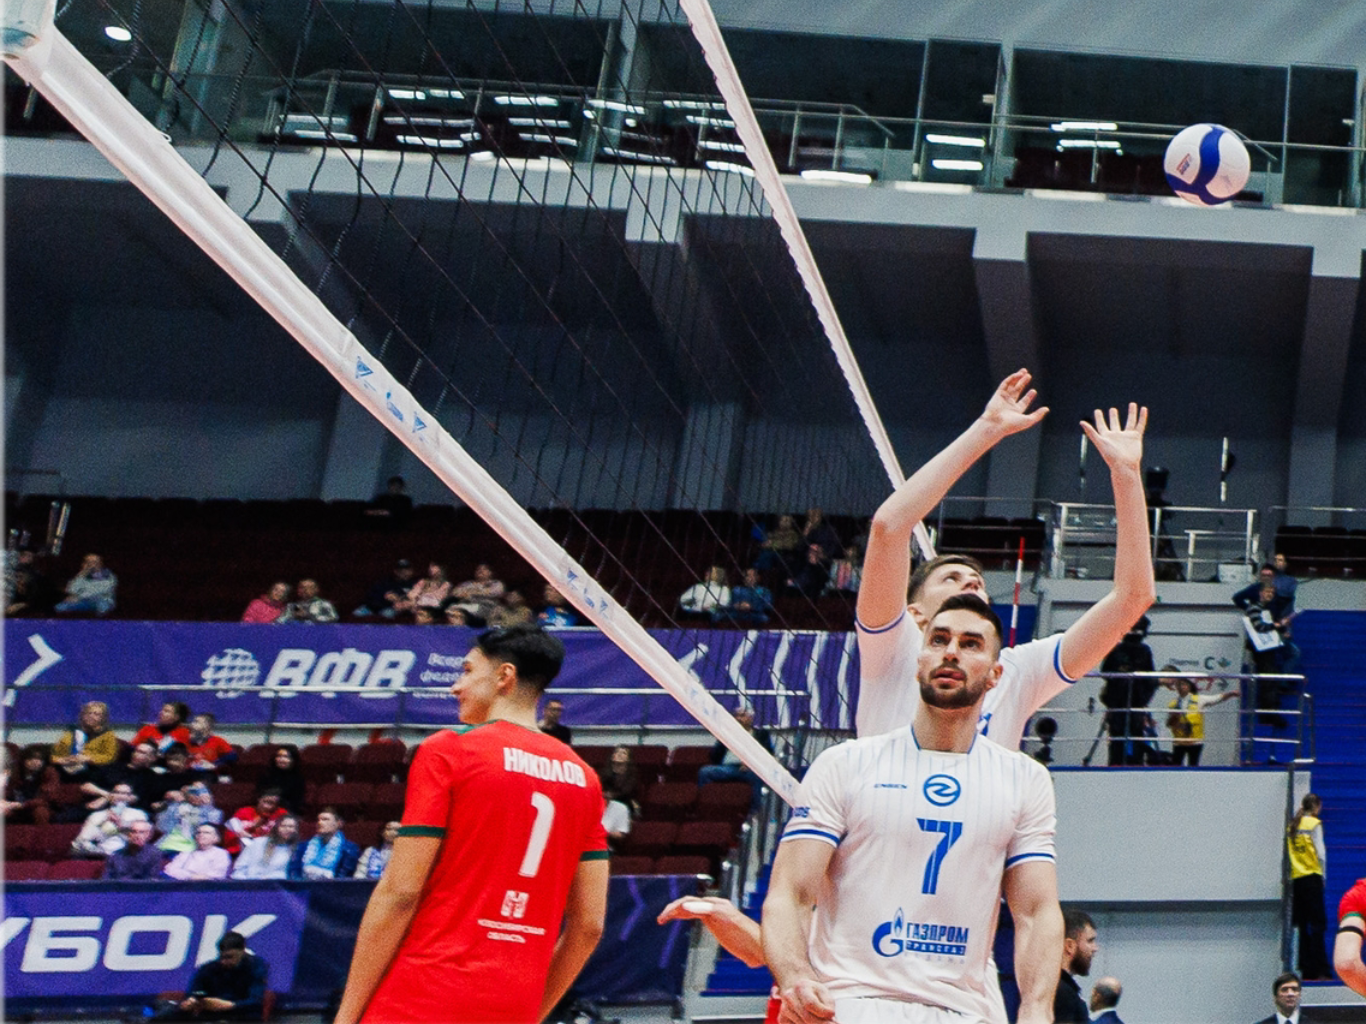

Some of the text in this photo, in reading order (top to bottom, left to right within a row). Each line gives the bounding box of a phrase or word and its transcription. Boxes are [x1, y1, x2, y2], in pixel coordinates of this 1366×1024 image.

[258, 648, 417, 699] ВФВ
[503, 747, 587, 788] НИКОЛОВ
[518, 791, 555, 878] 1
[916, 817, 963, 895] 7
[906, 922, 969, 944] ГАЗПРОМ
